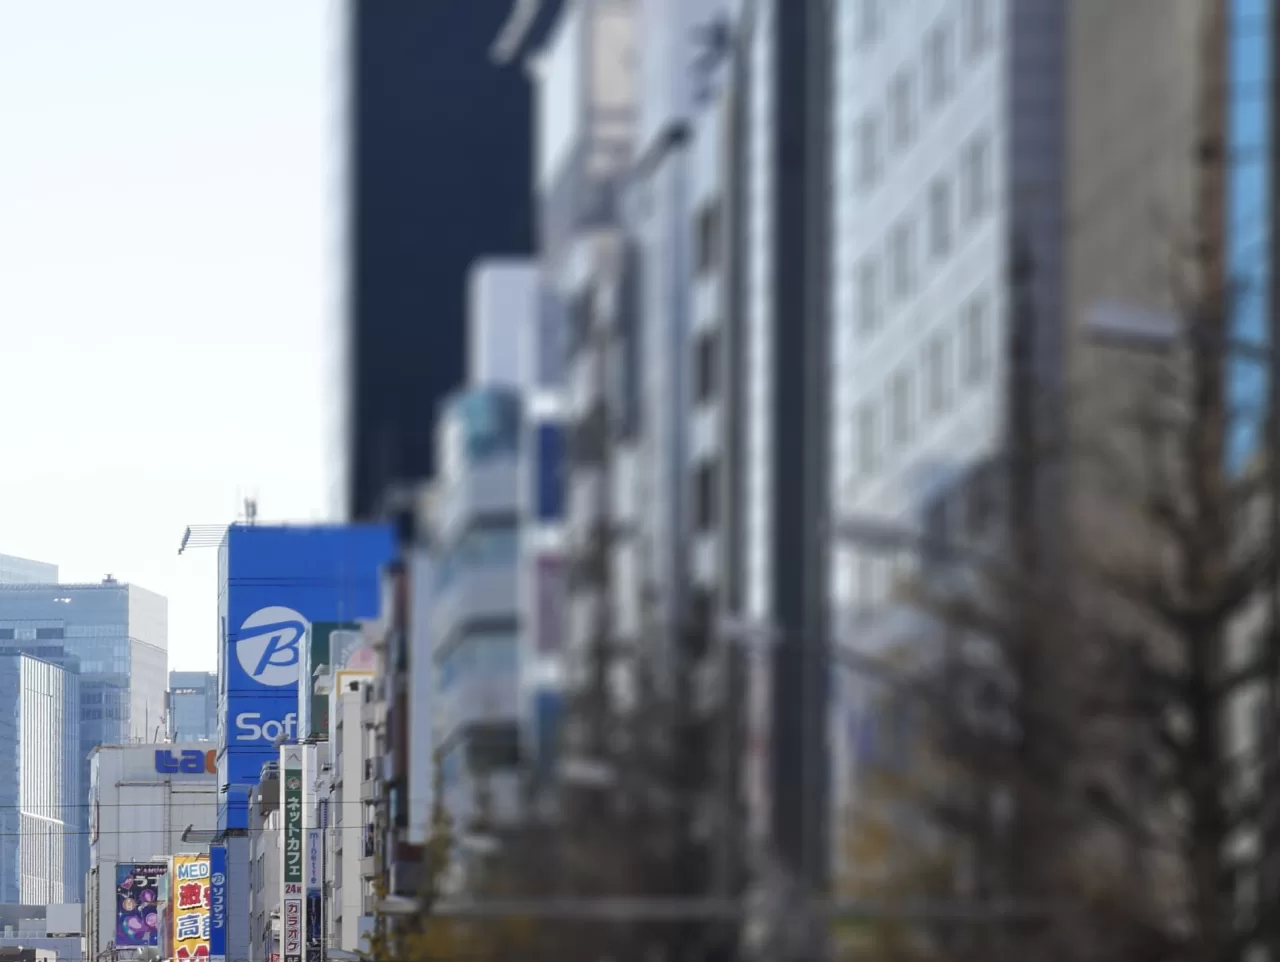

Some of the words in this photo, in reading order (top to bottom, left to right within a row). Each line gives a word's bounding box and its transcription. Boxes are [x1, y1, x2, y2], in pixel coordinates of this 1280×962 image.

[235, 712, 298, 742] Sof
[286, 797, 301, 876] ネットカフェ
[179, 882, 210, 908] 激
[213, 887, 224, 929] ソフマップ
[178, 914, 210, 939] 高
[288, 904, 299, 951] カラオケ
